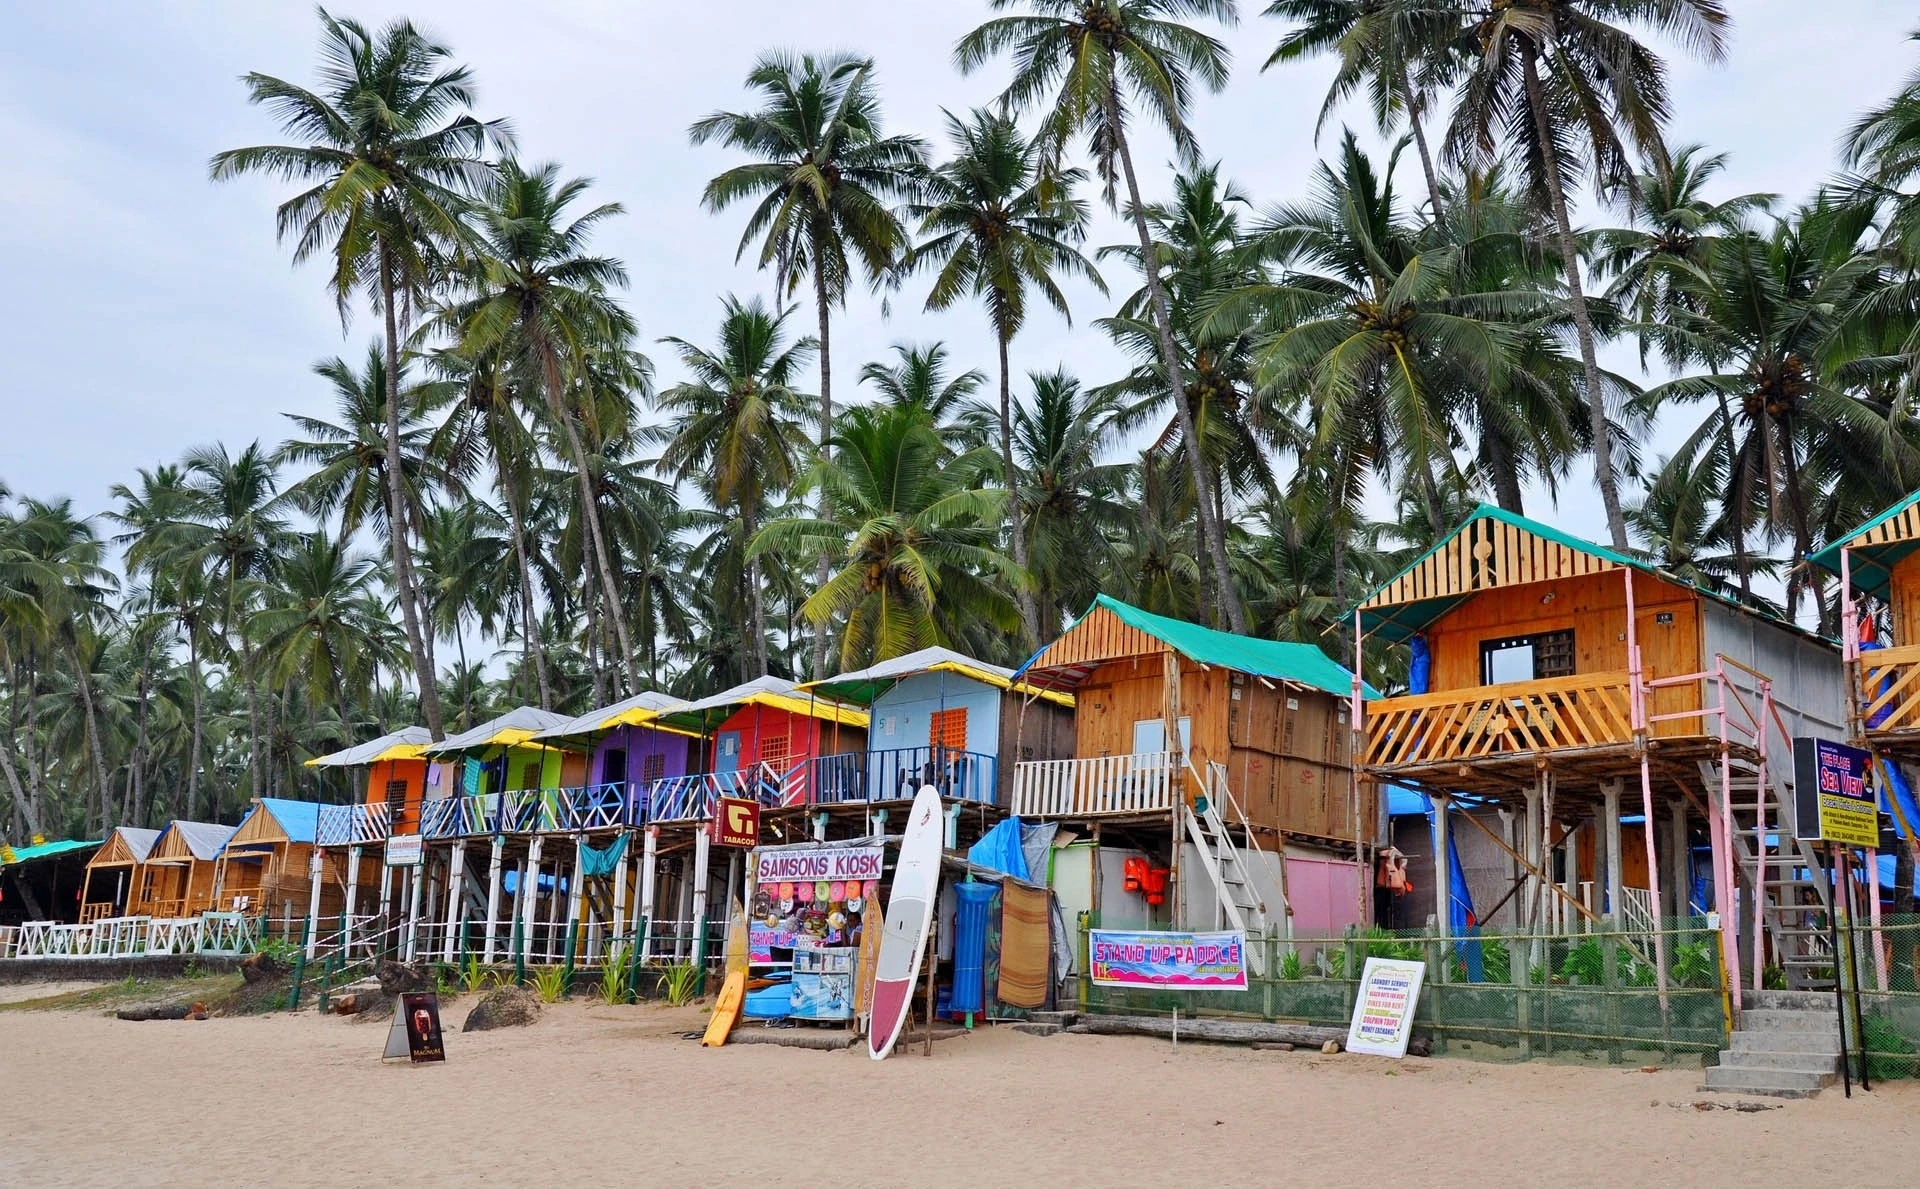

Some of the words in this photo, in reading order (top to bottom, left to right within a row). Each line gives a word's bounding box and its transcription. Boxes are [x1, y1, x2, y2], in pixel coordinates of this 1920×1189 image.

[1820, 751, 1833, 767] THE
[1822, 795, 1839, 809] Beach
[723, 835, 755, 846] TABACOS
[760, 856, 829, 877] SAMSONS
[836, 854, 881, 875] KIOSK
[750, 931, 775, 945] TAND
[779, 932, 793, 946] UP
[1096, 942, 1145, 963] STAND
[1150, 944, 1171, 965] UP
[1174, 943, 1240, 965] PADDLE
[1371, 978, 1390, 986] LAUNDRY
[1390, 980, 1408, 988] SERVICE
[1363, 1016, 1383, 1026] DOLPHIN
[1384, 1018, 1398, 1028] TRIPS
[1375, 1027, 1395, 1036] EXCHANGE
[414, 1048, 441, 1056] MAGNUM
